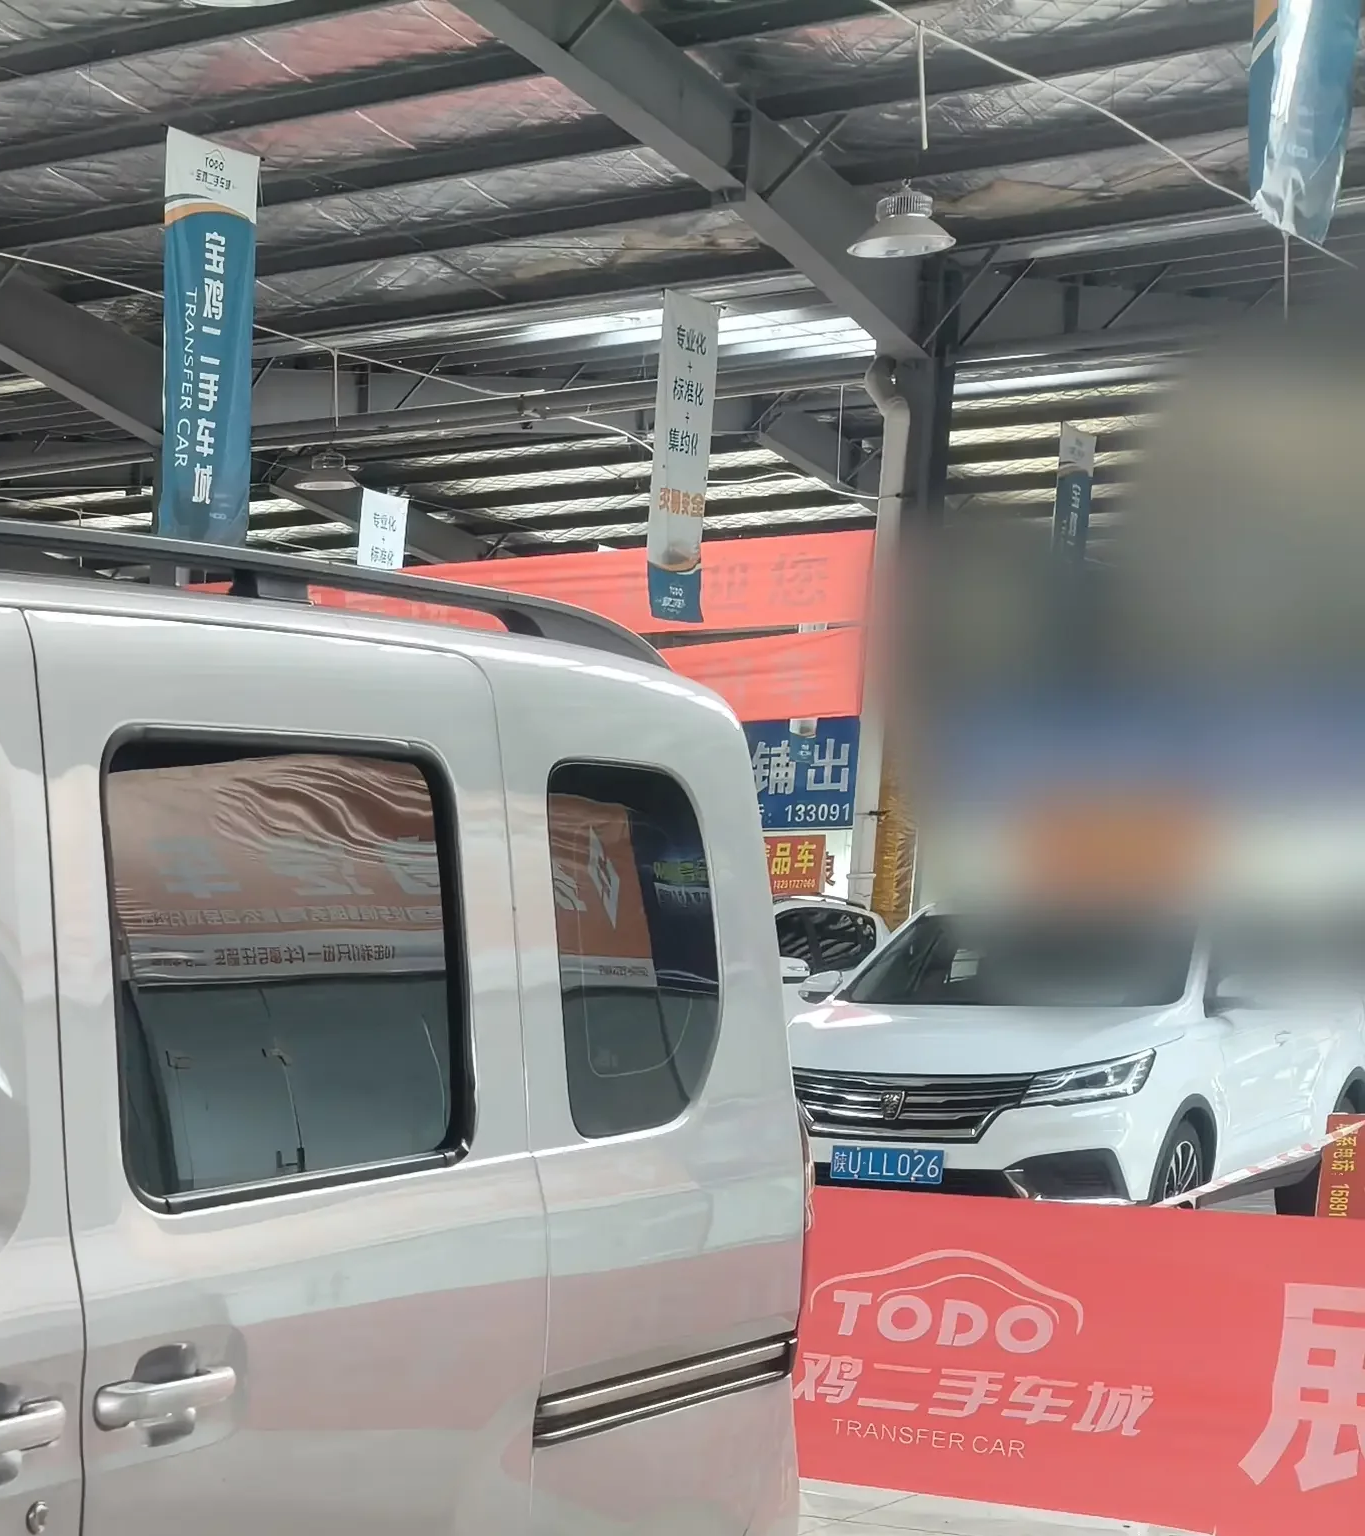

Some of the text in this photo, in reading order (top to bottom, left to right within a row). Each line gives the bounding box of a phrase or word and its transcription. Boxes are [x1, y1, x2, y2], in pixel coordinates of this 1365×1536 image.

[676, 324, 707, 356] 专业化
[173, 290, 197, 468] TRANSFER CAR
[191, 231, 226, 504] 宝鸡二手车城
[673, 376, 704, 406] 标准化
[668, 428, 699, 456] 集约化
[784, 803, 851, 822] 133091
[765, 841, 817, 876] 品车
[833, 1290, 1057, 1354] TODO
[793, 1351, 1155, 1437] 鸡二手车城
[832, 1418, 1027, 1459] TRANSFER CAR
